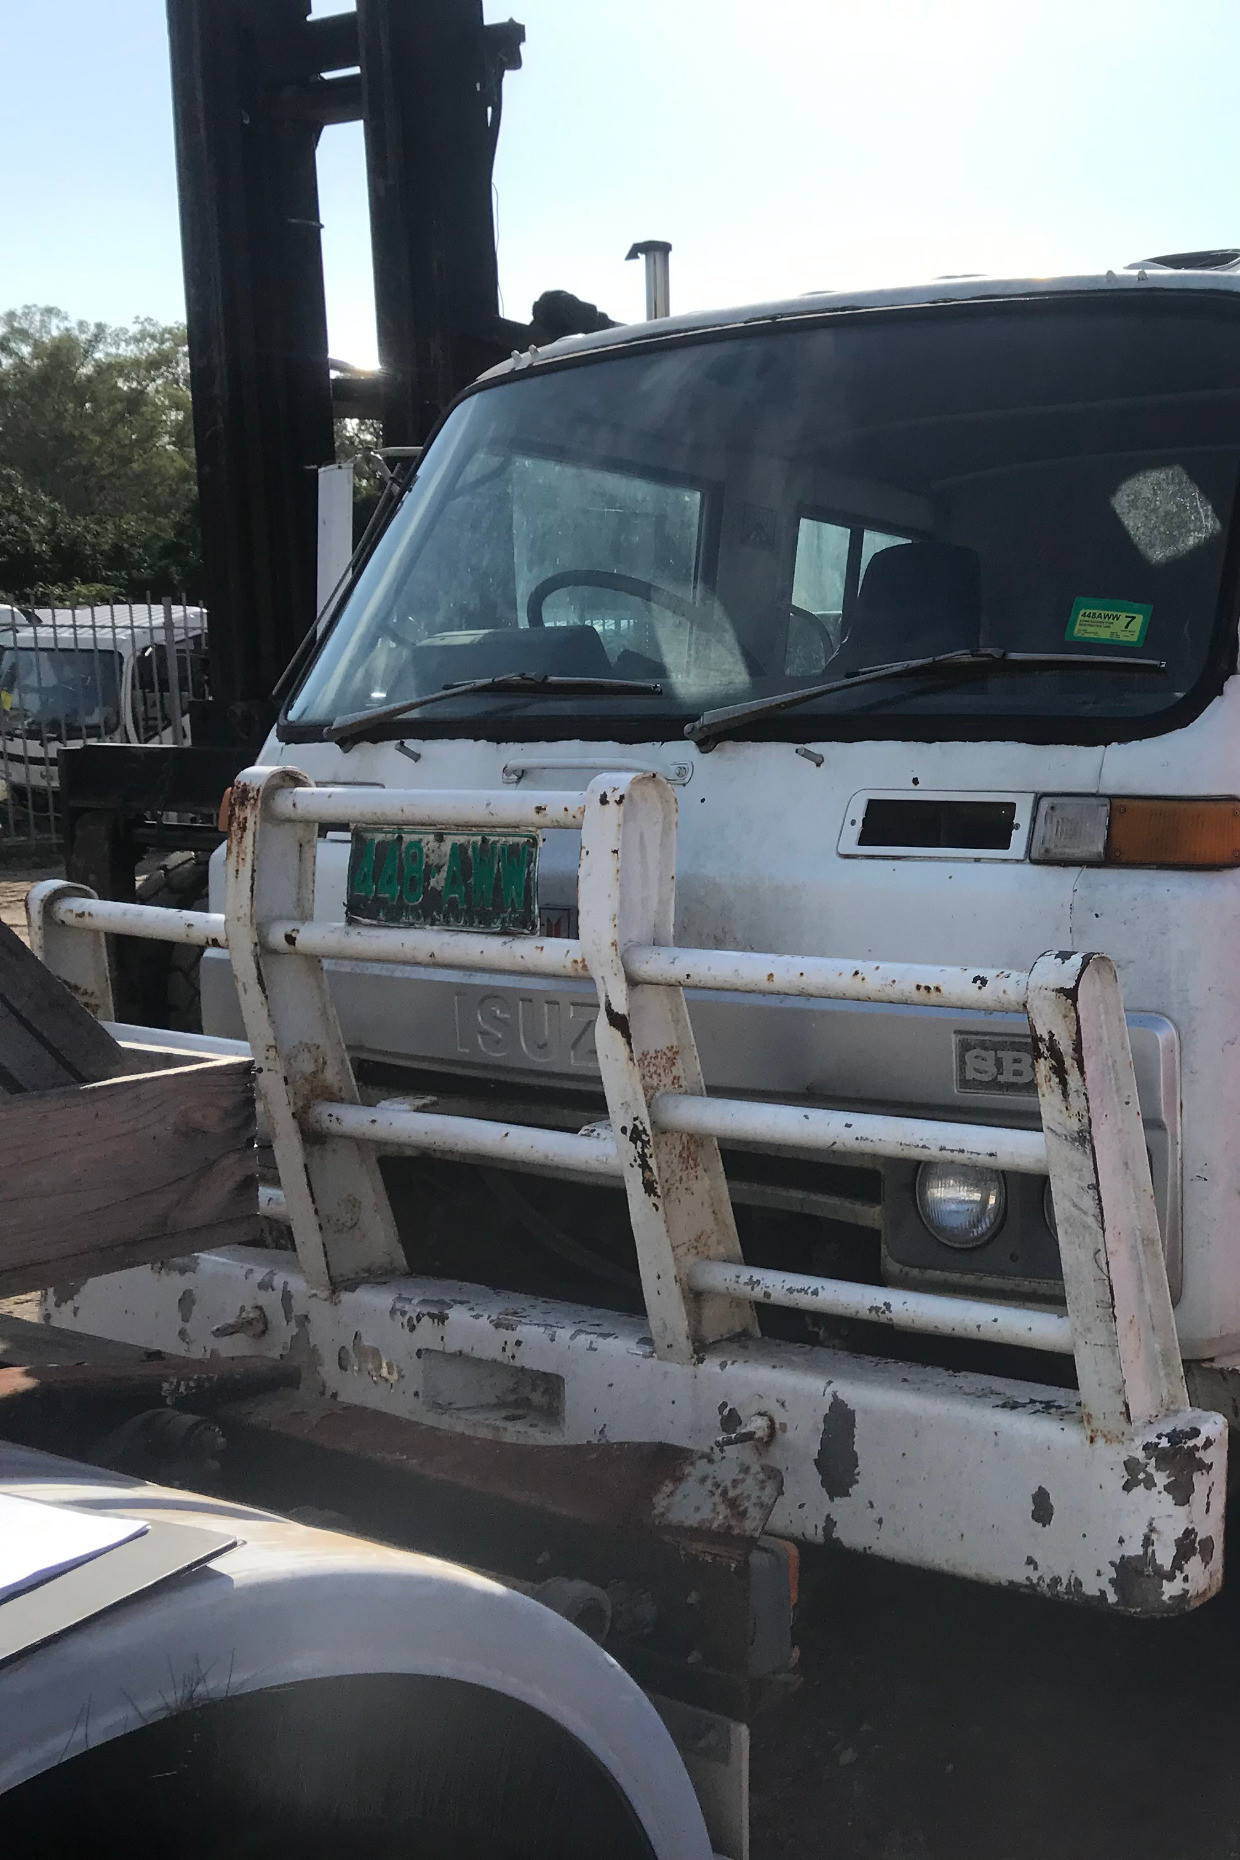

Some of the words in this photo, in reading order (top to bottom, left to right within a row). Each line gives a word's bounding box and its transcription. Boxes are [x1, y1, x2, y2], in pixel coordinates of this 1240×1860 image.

[1080, 611, 1122, 621] 448AWW
[1124, 615, 1136, 630] 7
[352, 837, 424, 905] 448
[443, 841, 530, 912] AWW
[454, 991, 600, 1068] ISUZ
